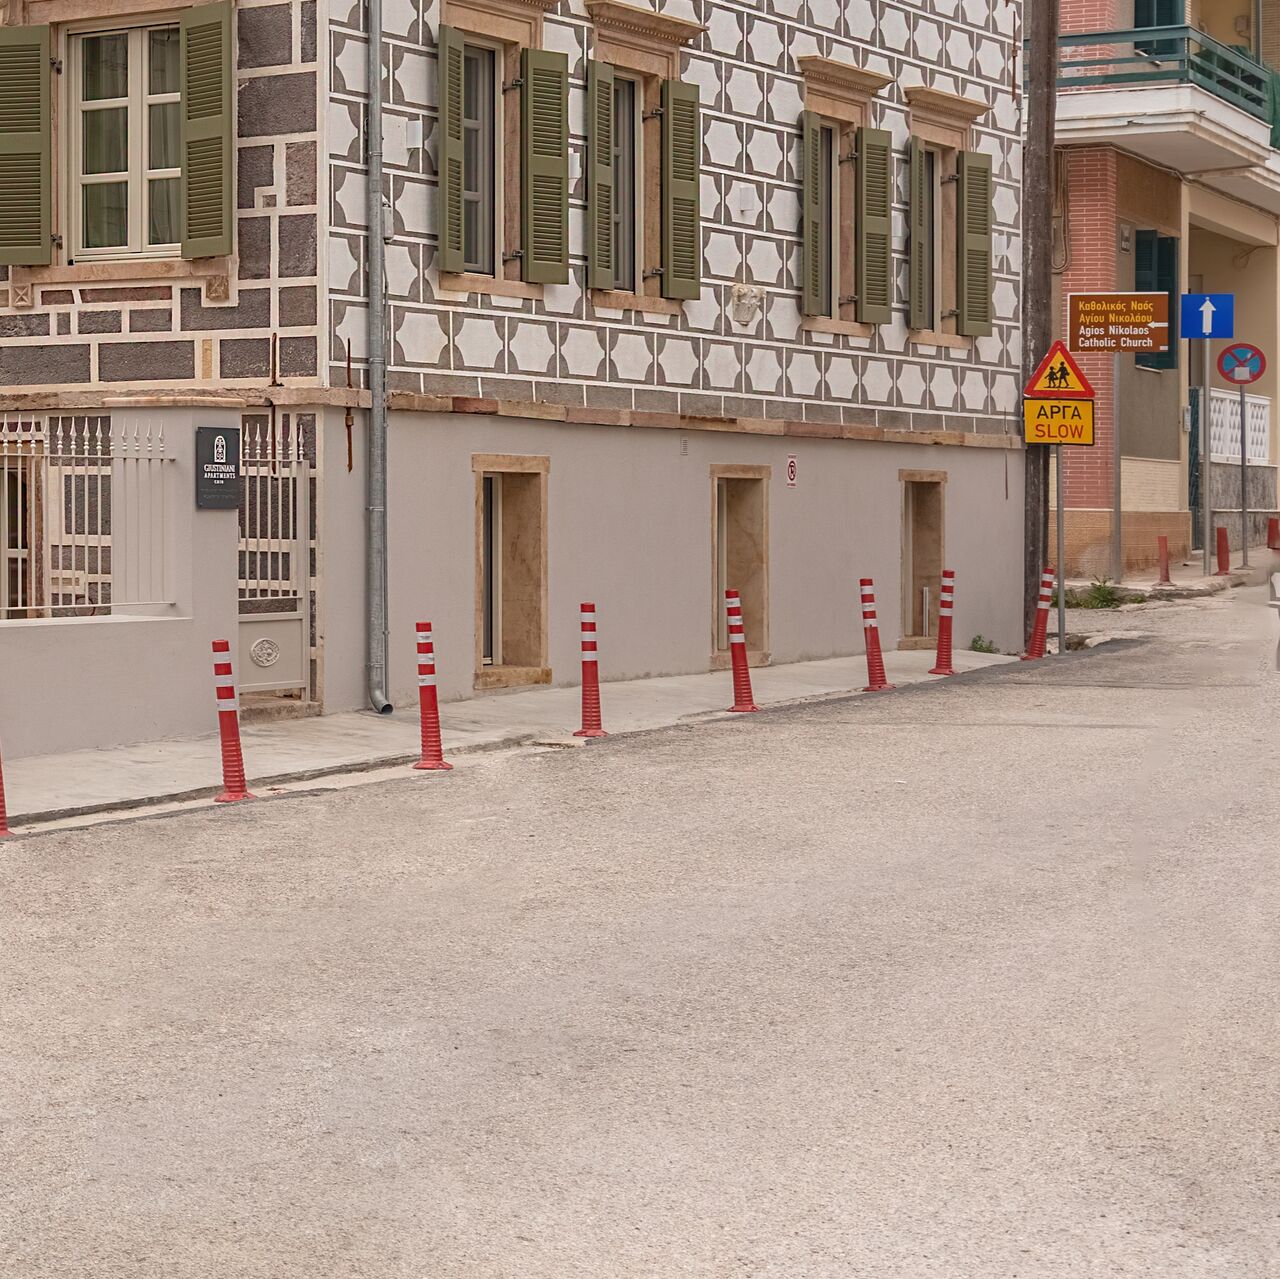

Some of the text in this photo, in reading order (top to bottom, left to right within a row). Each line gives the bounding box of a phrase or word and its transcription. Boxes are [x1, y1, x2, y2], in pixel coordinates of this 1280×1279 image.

[1078, 300, 1154, 312] Καθολικός Ναός
[1079, 313, 1153, 325] Αγίου Νικολάου
[1079, 325, 1150, 337] Agios Nikolaos
[1078, 337, 1153, 347] Catholic Church
[1036, 404, 1082, 420] ΑΡΓΑ
[1034, 423, 1084, 439] SLOW
